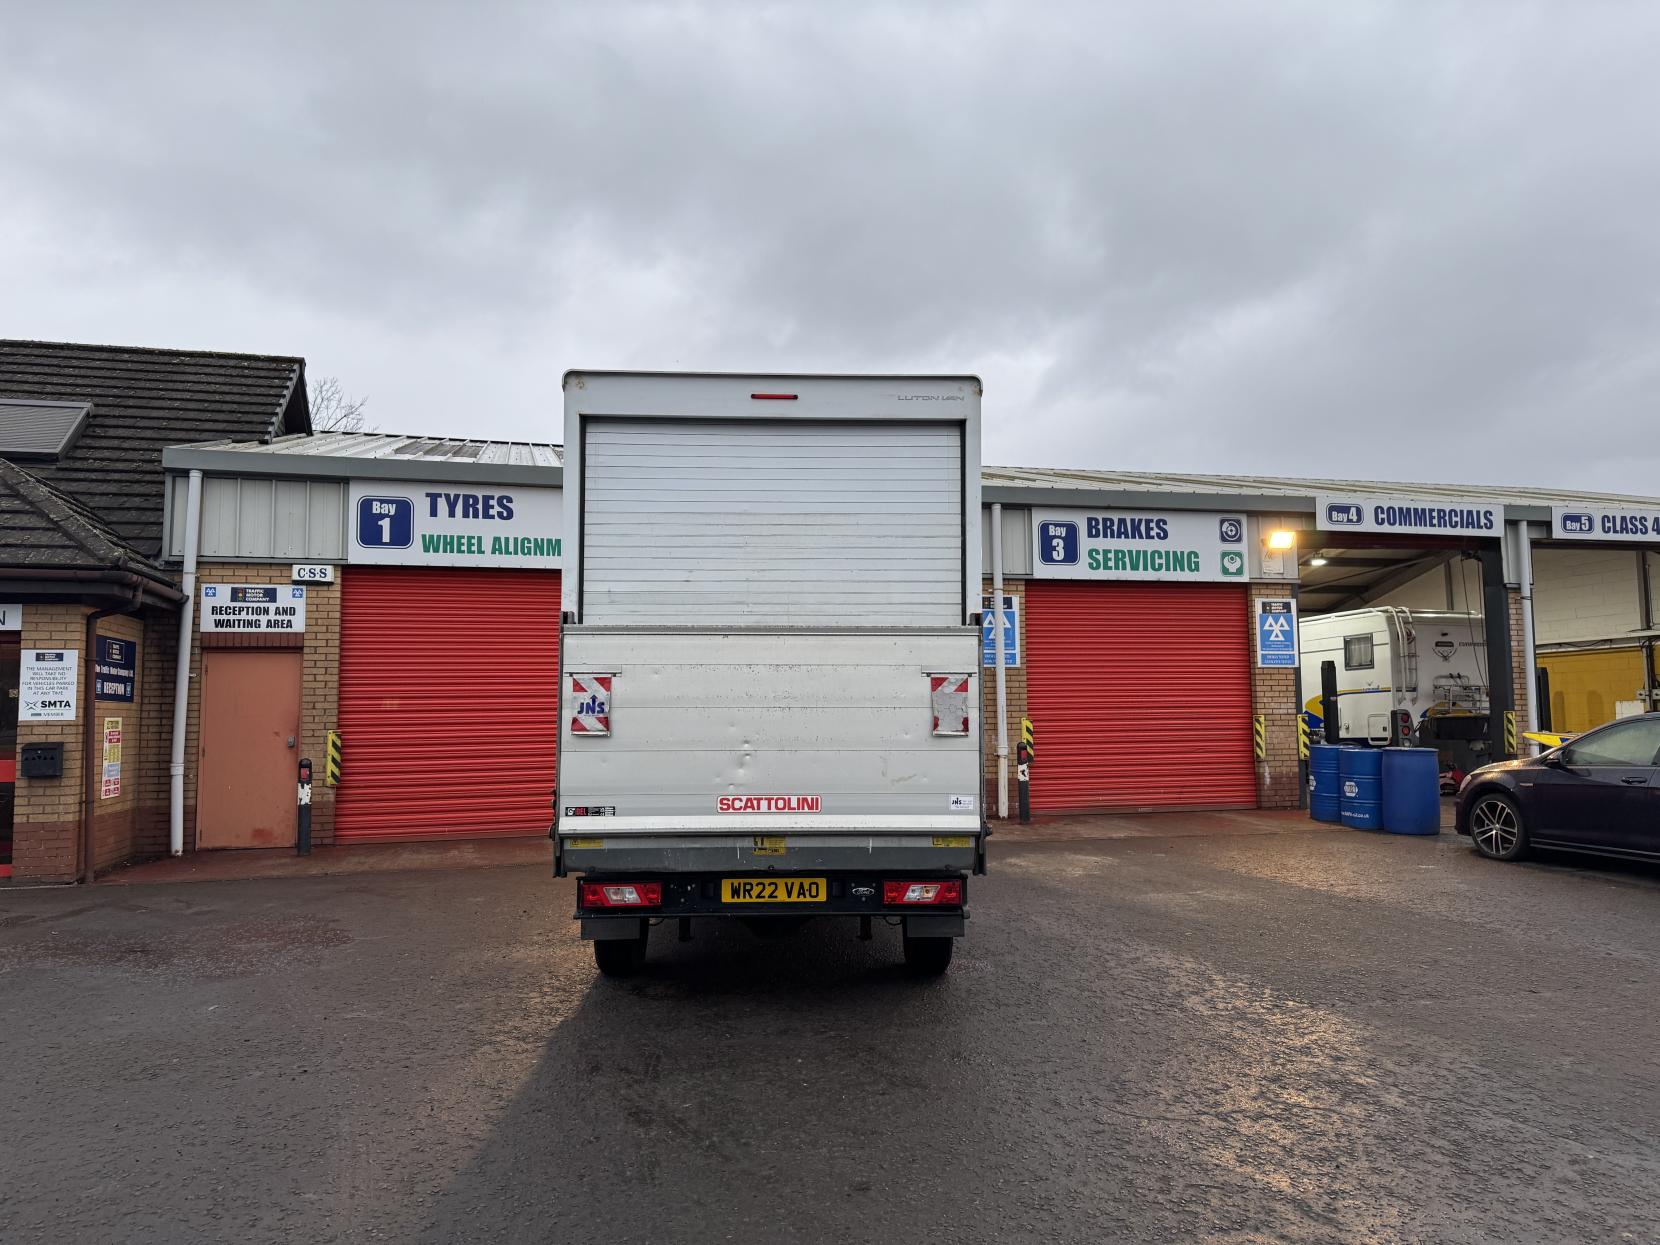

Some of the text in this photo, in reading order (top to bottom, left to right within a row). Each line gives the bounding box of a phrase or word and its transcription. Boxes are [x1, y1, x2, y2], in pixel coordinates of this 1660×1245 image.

[372, 501, 396, 516] Bay
[425, 492, 514, 520] TYRES
[1332, 507, 1358, 524] Bay 4
[1374, 505, 1494, 530] COMMERCIALS
[1566, 516, 1590, 532] Bay 5
[378, 518, 390, 542] 1
[1049, 525, 1066, 538] Bay
[1087, 516, 1168, 540] BRAKES
[1602, 514, 1660, 536] CLASS 4
[421, 533, 486, 554] WHEEL
[1052, 538, 1065, 561] 3
[1088, 548, 1200, 573] SERVICING
[212, 606, 296, 616] RECEPTION AND
[214, 619, 293, 629] WAITING AREA
[104, 682, 124, 695] RECEPTION
[40, 700, 71, 708] SMTA
[577, 696, 605, 714] JNS
[718, 797, 820, 811] SCATTOLINI
[730, 882, 820, 899] WR22 VAO
